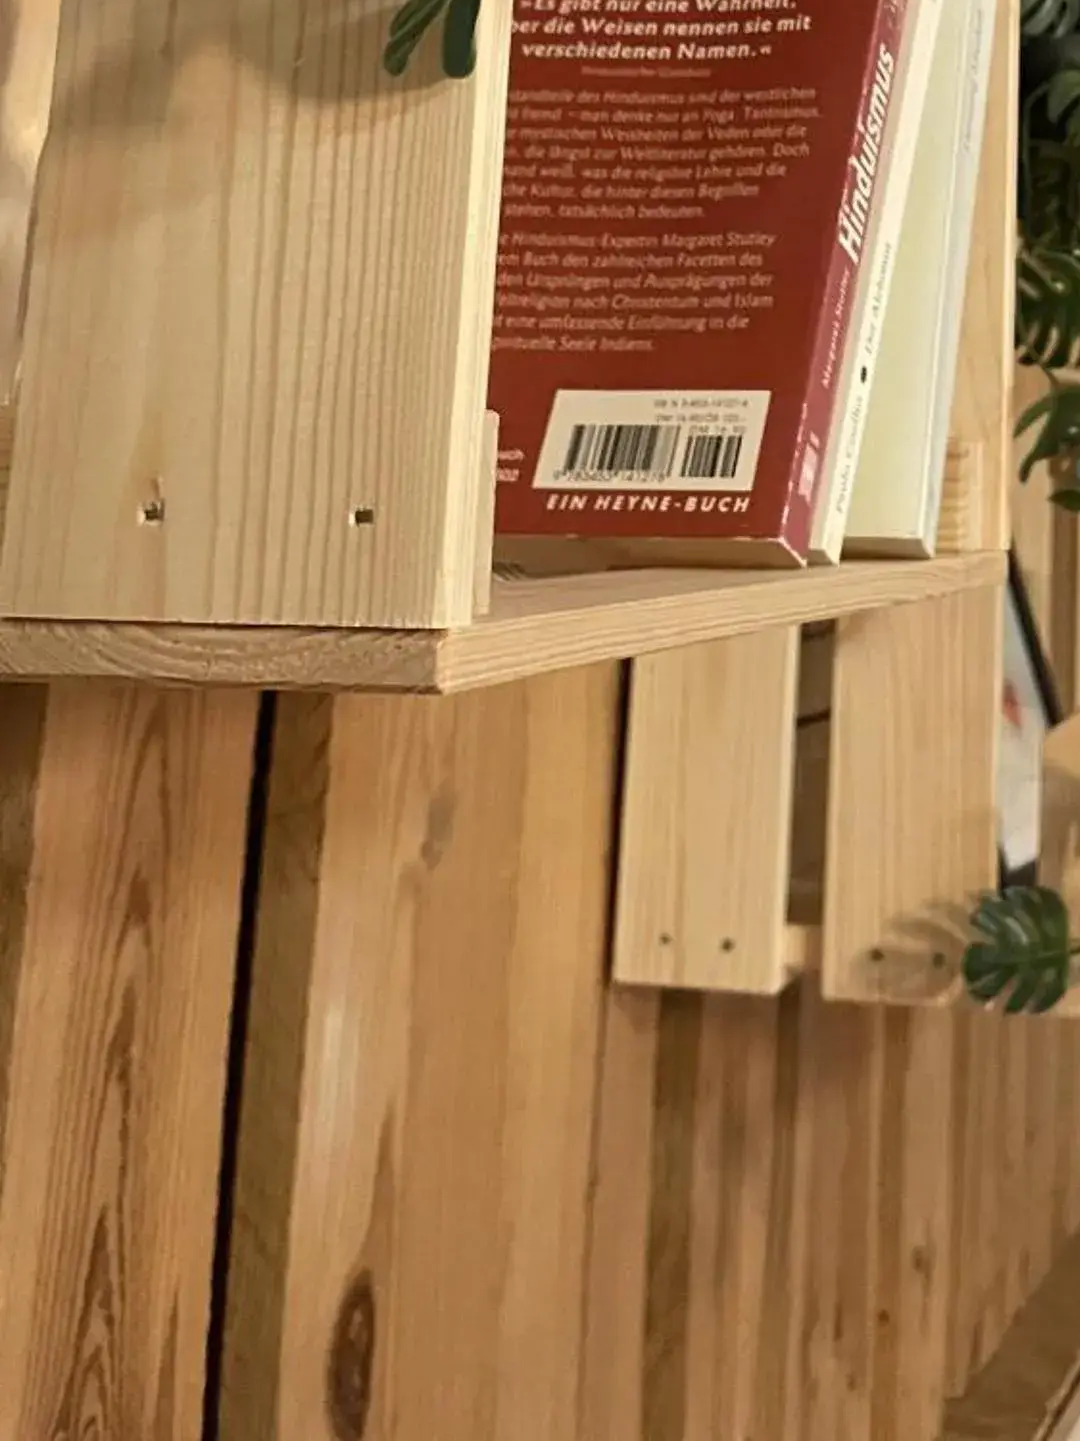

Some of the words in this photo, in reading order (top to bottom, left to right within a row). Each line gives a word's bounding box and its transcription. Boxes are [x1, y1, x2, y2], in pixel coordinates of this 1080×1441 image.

[543, 16, 576, 34] die
[581, 17, 658, 35] Weisen
[663, 21, 739, 36] nennen
[743, 16, 772, 34] sie
[776, 13, 812, 31] mit
[521, 41, 671, 59] verschiedenen
[838, 42, 894, 264] Hinduismus
[547, 494, 587, 510] EIN
[594, 495, 750, 512] HEYNE-BUCH
